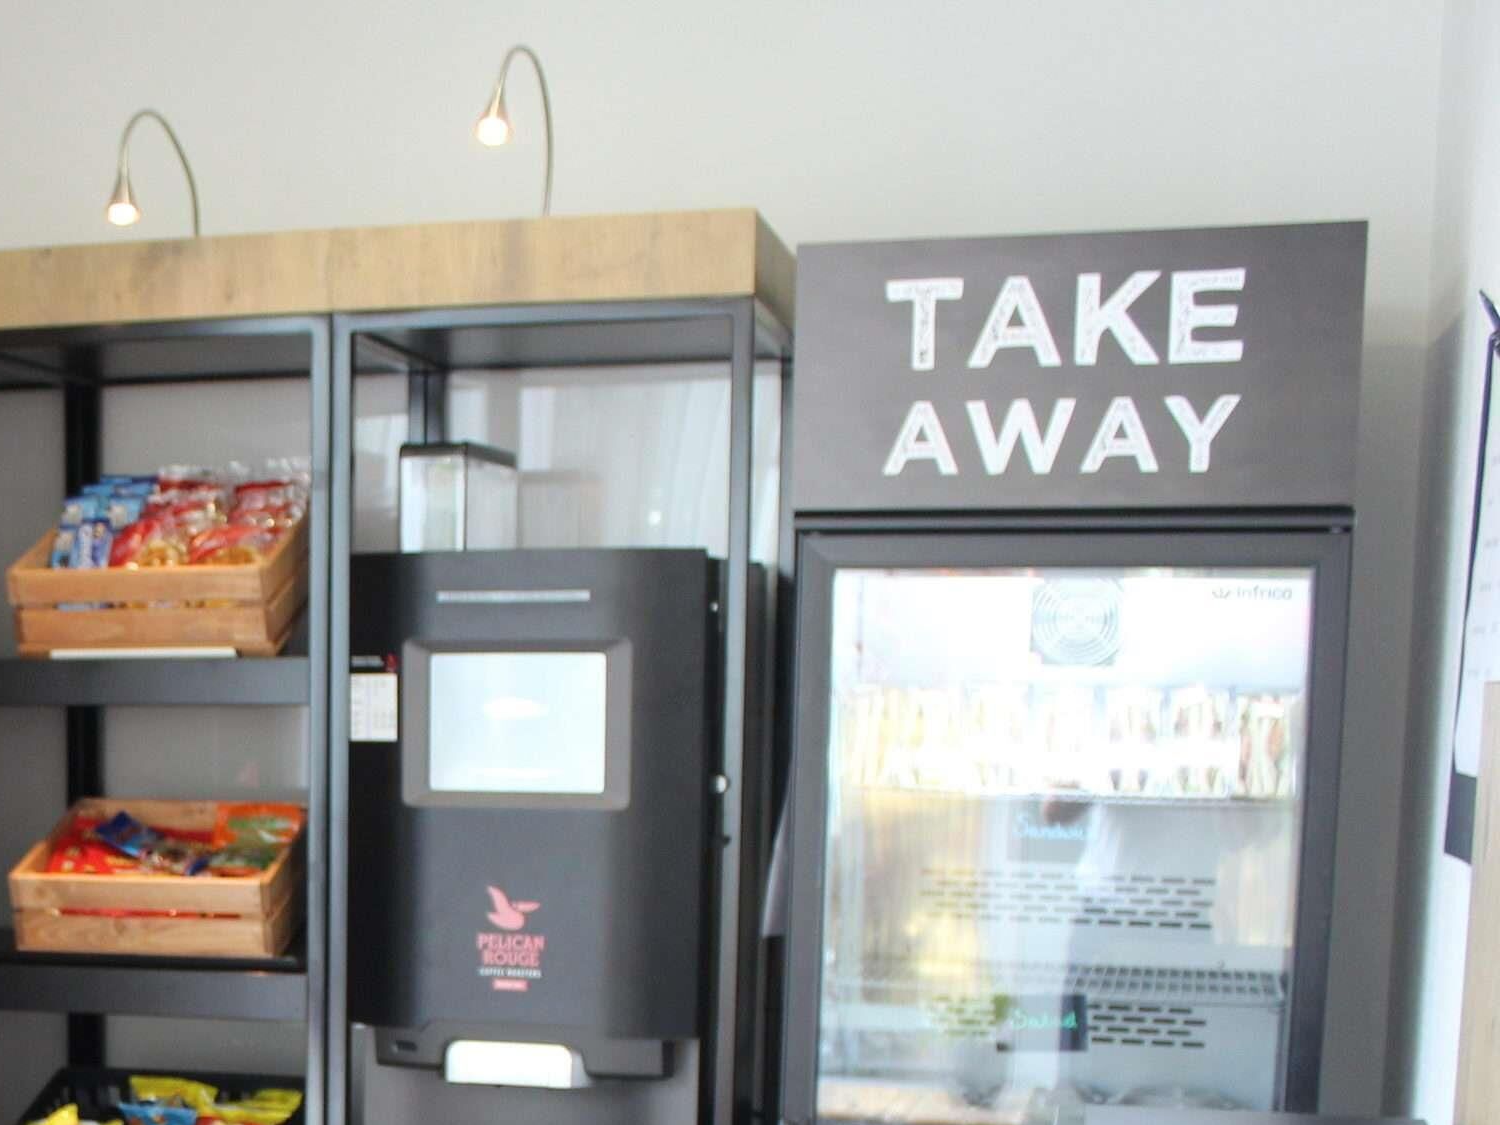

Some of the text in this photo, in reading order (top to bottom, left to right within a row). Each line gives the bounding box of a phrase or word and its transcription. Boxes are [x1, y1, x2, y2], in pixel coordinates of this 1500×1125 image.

[885, 268, 1246, 371] TAKE
[882, 394, 1241, 476] AWAY
[476, 933, 545, 951] PELICAN
[483, 950, 540, 966] ROUGE
